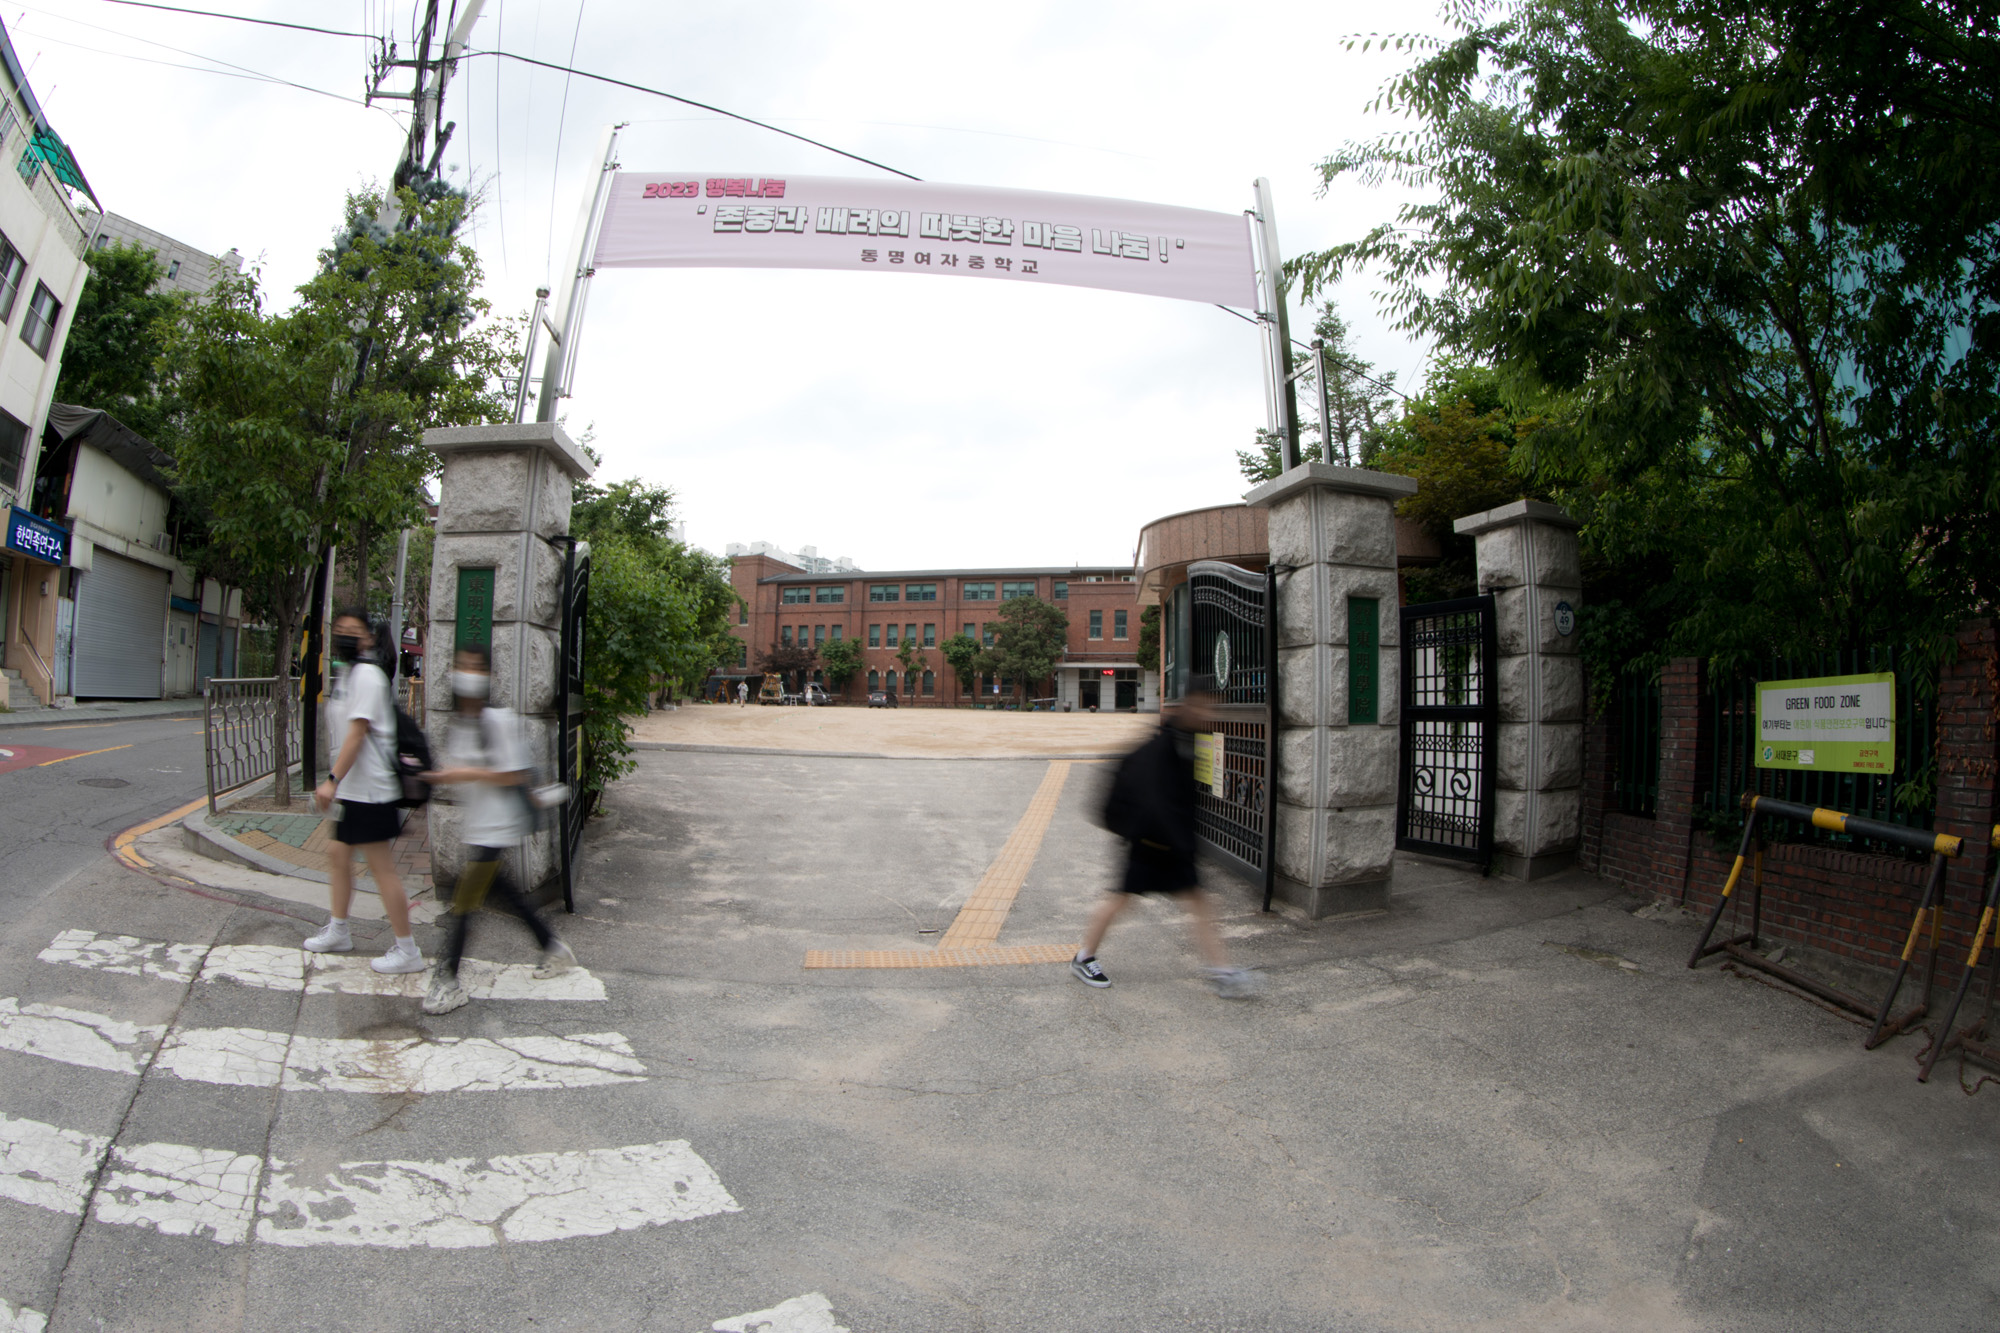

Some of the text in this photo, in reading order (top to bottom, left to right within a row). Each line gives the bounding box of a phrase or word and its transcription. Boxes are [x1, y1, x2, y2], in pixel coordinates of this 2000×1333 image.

[642, 178, 786, 199] 2023 행복나눔
[816, 206, 911, 238] 배려의
[919, 212, 1014, 246] 따뜻한
[1022, 220, 1082, 253] 마음
[16, 524, 61, 559] 한민족연구소
[1559, 615, 1570, 626] 49
[1785, 694, 1861, 710] GREEN FOOD ZONE
[1762, 719, 1792, 730] 여기부터는
[1774, 750, 1798, 761] 서대문구
